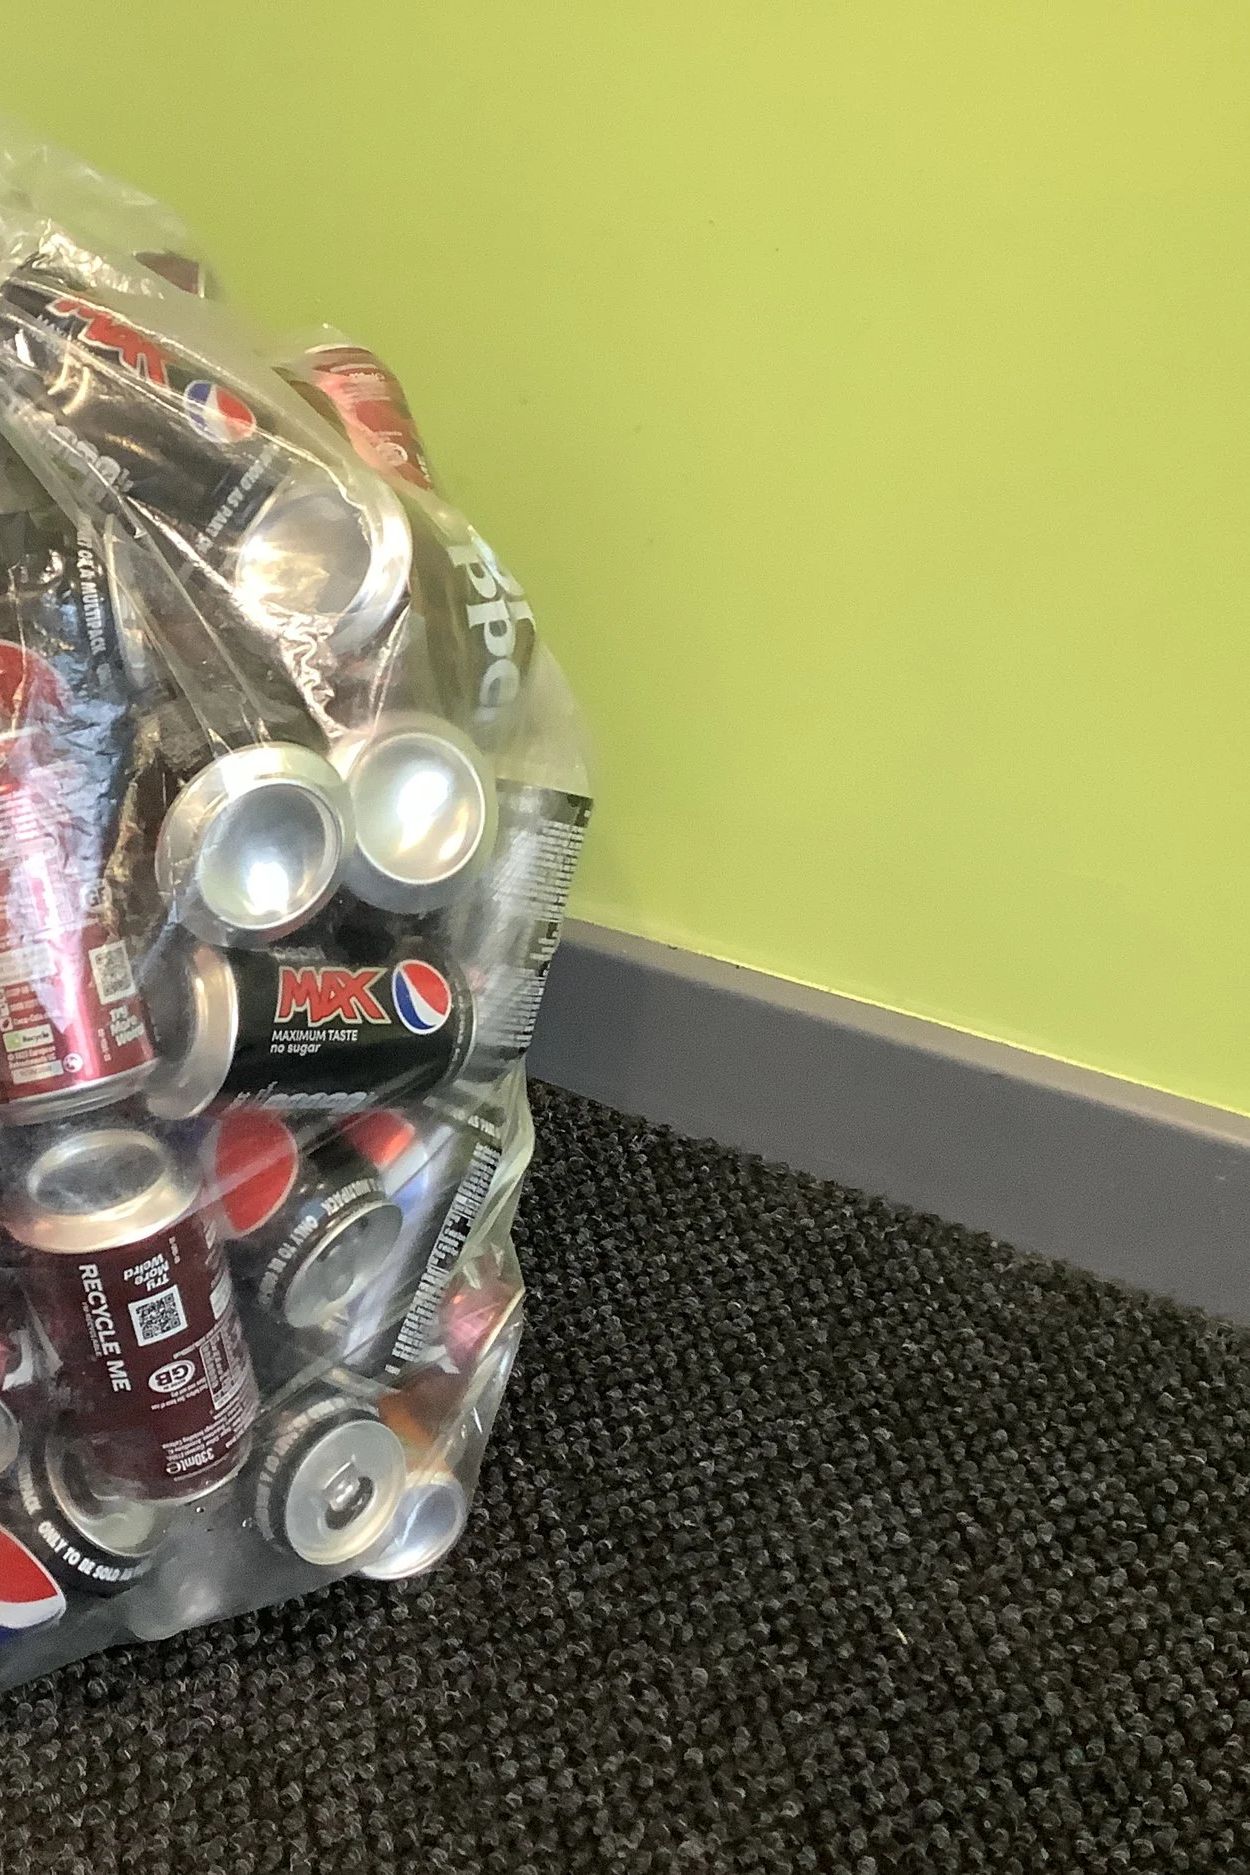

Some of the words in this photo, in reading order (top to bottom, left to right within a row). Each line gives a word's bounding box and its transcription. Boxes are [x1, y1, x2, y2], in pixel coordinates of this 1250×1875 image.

[81, 581, 107, 655] MULTIPACK
[274, 966, 392, 1027] MAX
[271, 1030, 326, 1041] MAXIMUM
[328, 1029, 359, 1041] TASTE
[270, 1044, 285, 1054] no
[287, 1043, 321, 1056] sugar
[123, 1253, 164, 1281] Weird
[134, 1260, 170, 1285] More
[146, 1273, 171, 1292] Try
[78, 1263, 121, 1355] RECYCLE
[106, 1359, 132, 1393] ME
[154, 1364, 189, 1387] GB
[38, 1521, 69, 1553] ONLY
[62, 1546, 81, 1565] TO
[77, 1557, 96, 1575] BE
[92, 1565, 121, 1581] SOLD
